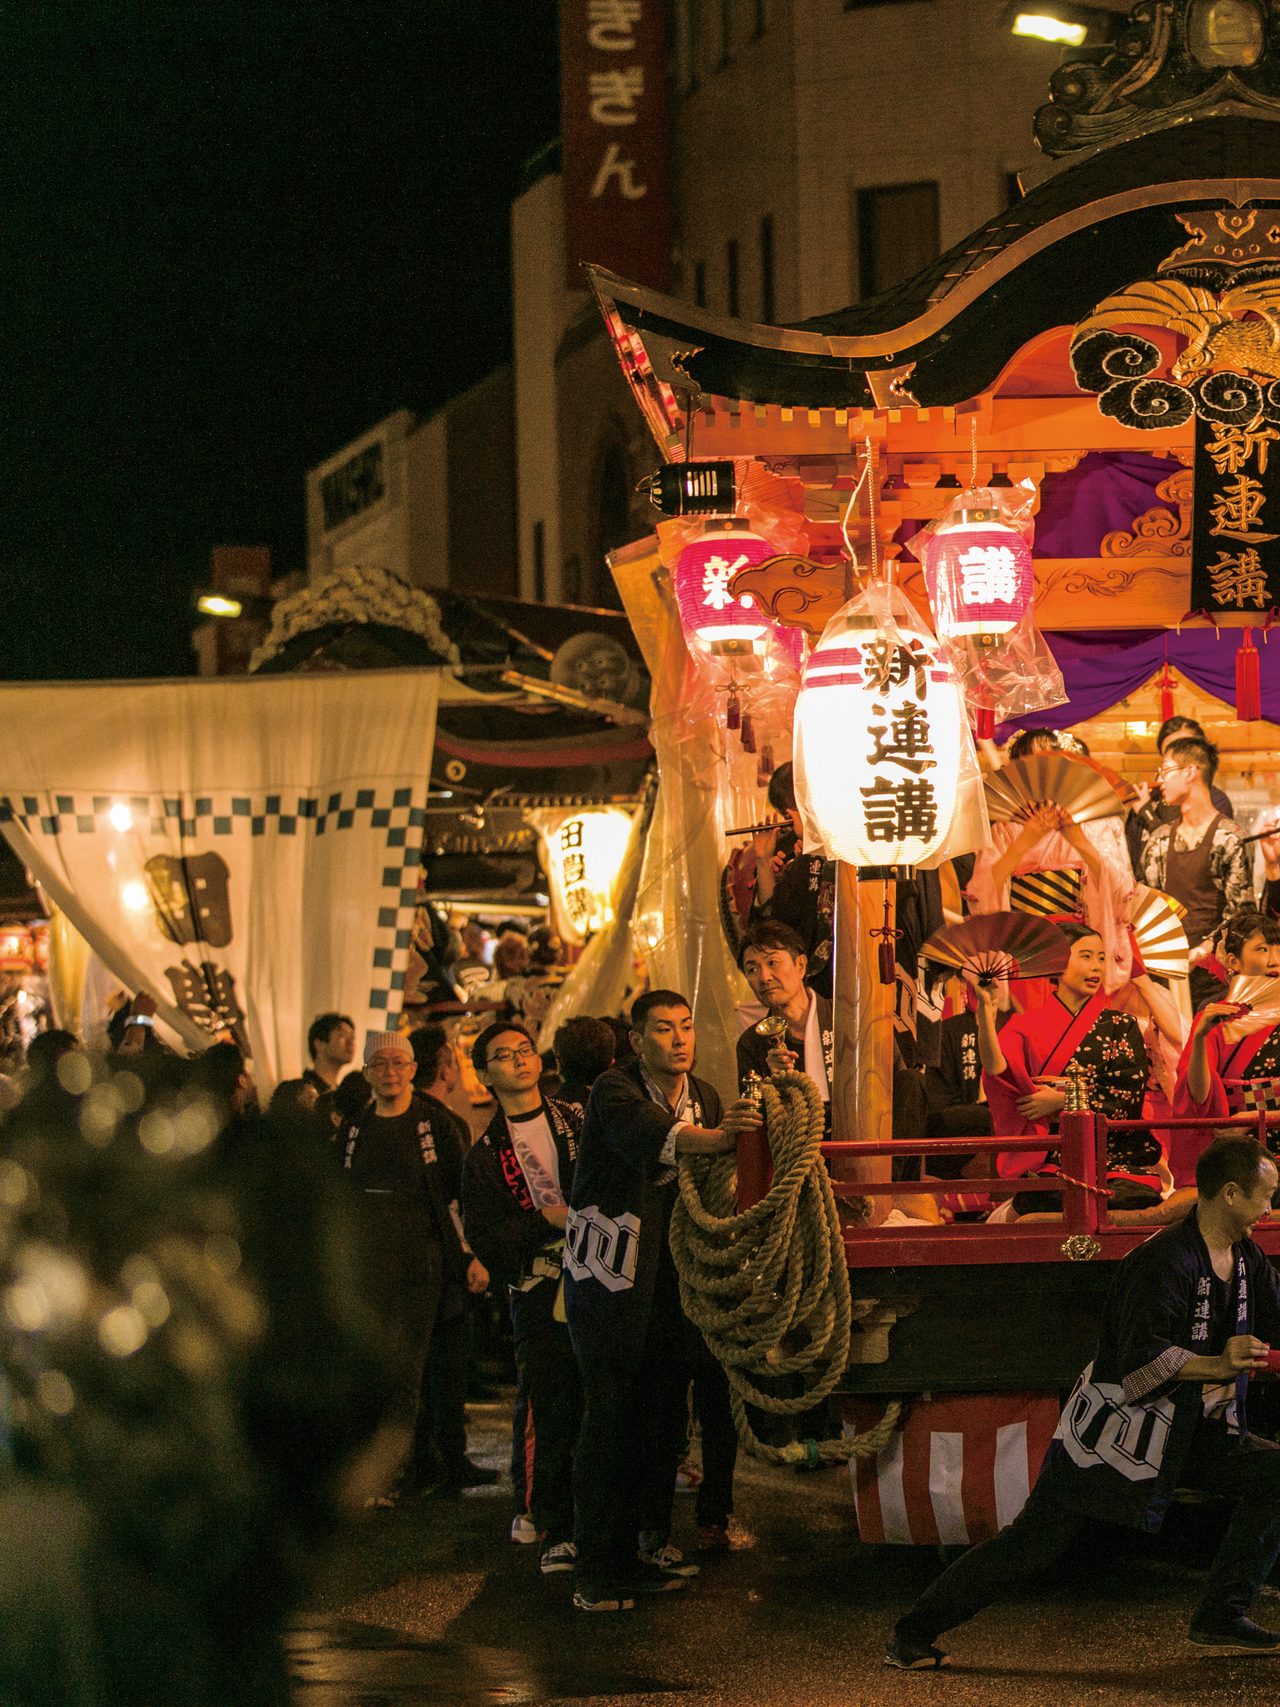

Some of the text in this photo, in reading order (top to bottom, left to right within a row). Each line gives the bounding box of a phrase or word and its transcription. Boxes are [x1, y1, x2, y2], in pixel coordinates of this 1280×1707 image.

[1204, 415, 1280, 608] 新連講
[958, 546, 1017, 604] 講
[860, 638, 938, 844] 新連講
[961, 1033, 977, 1080] 新連講
[1191, 1276, 1212, 1341] 新連講
